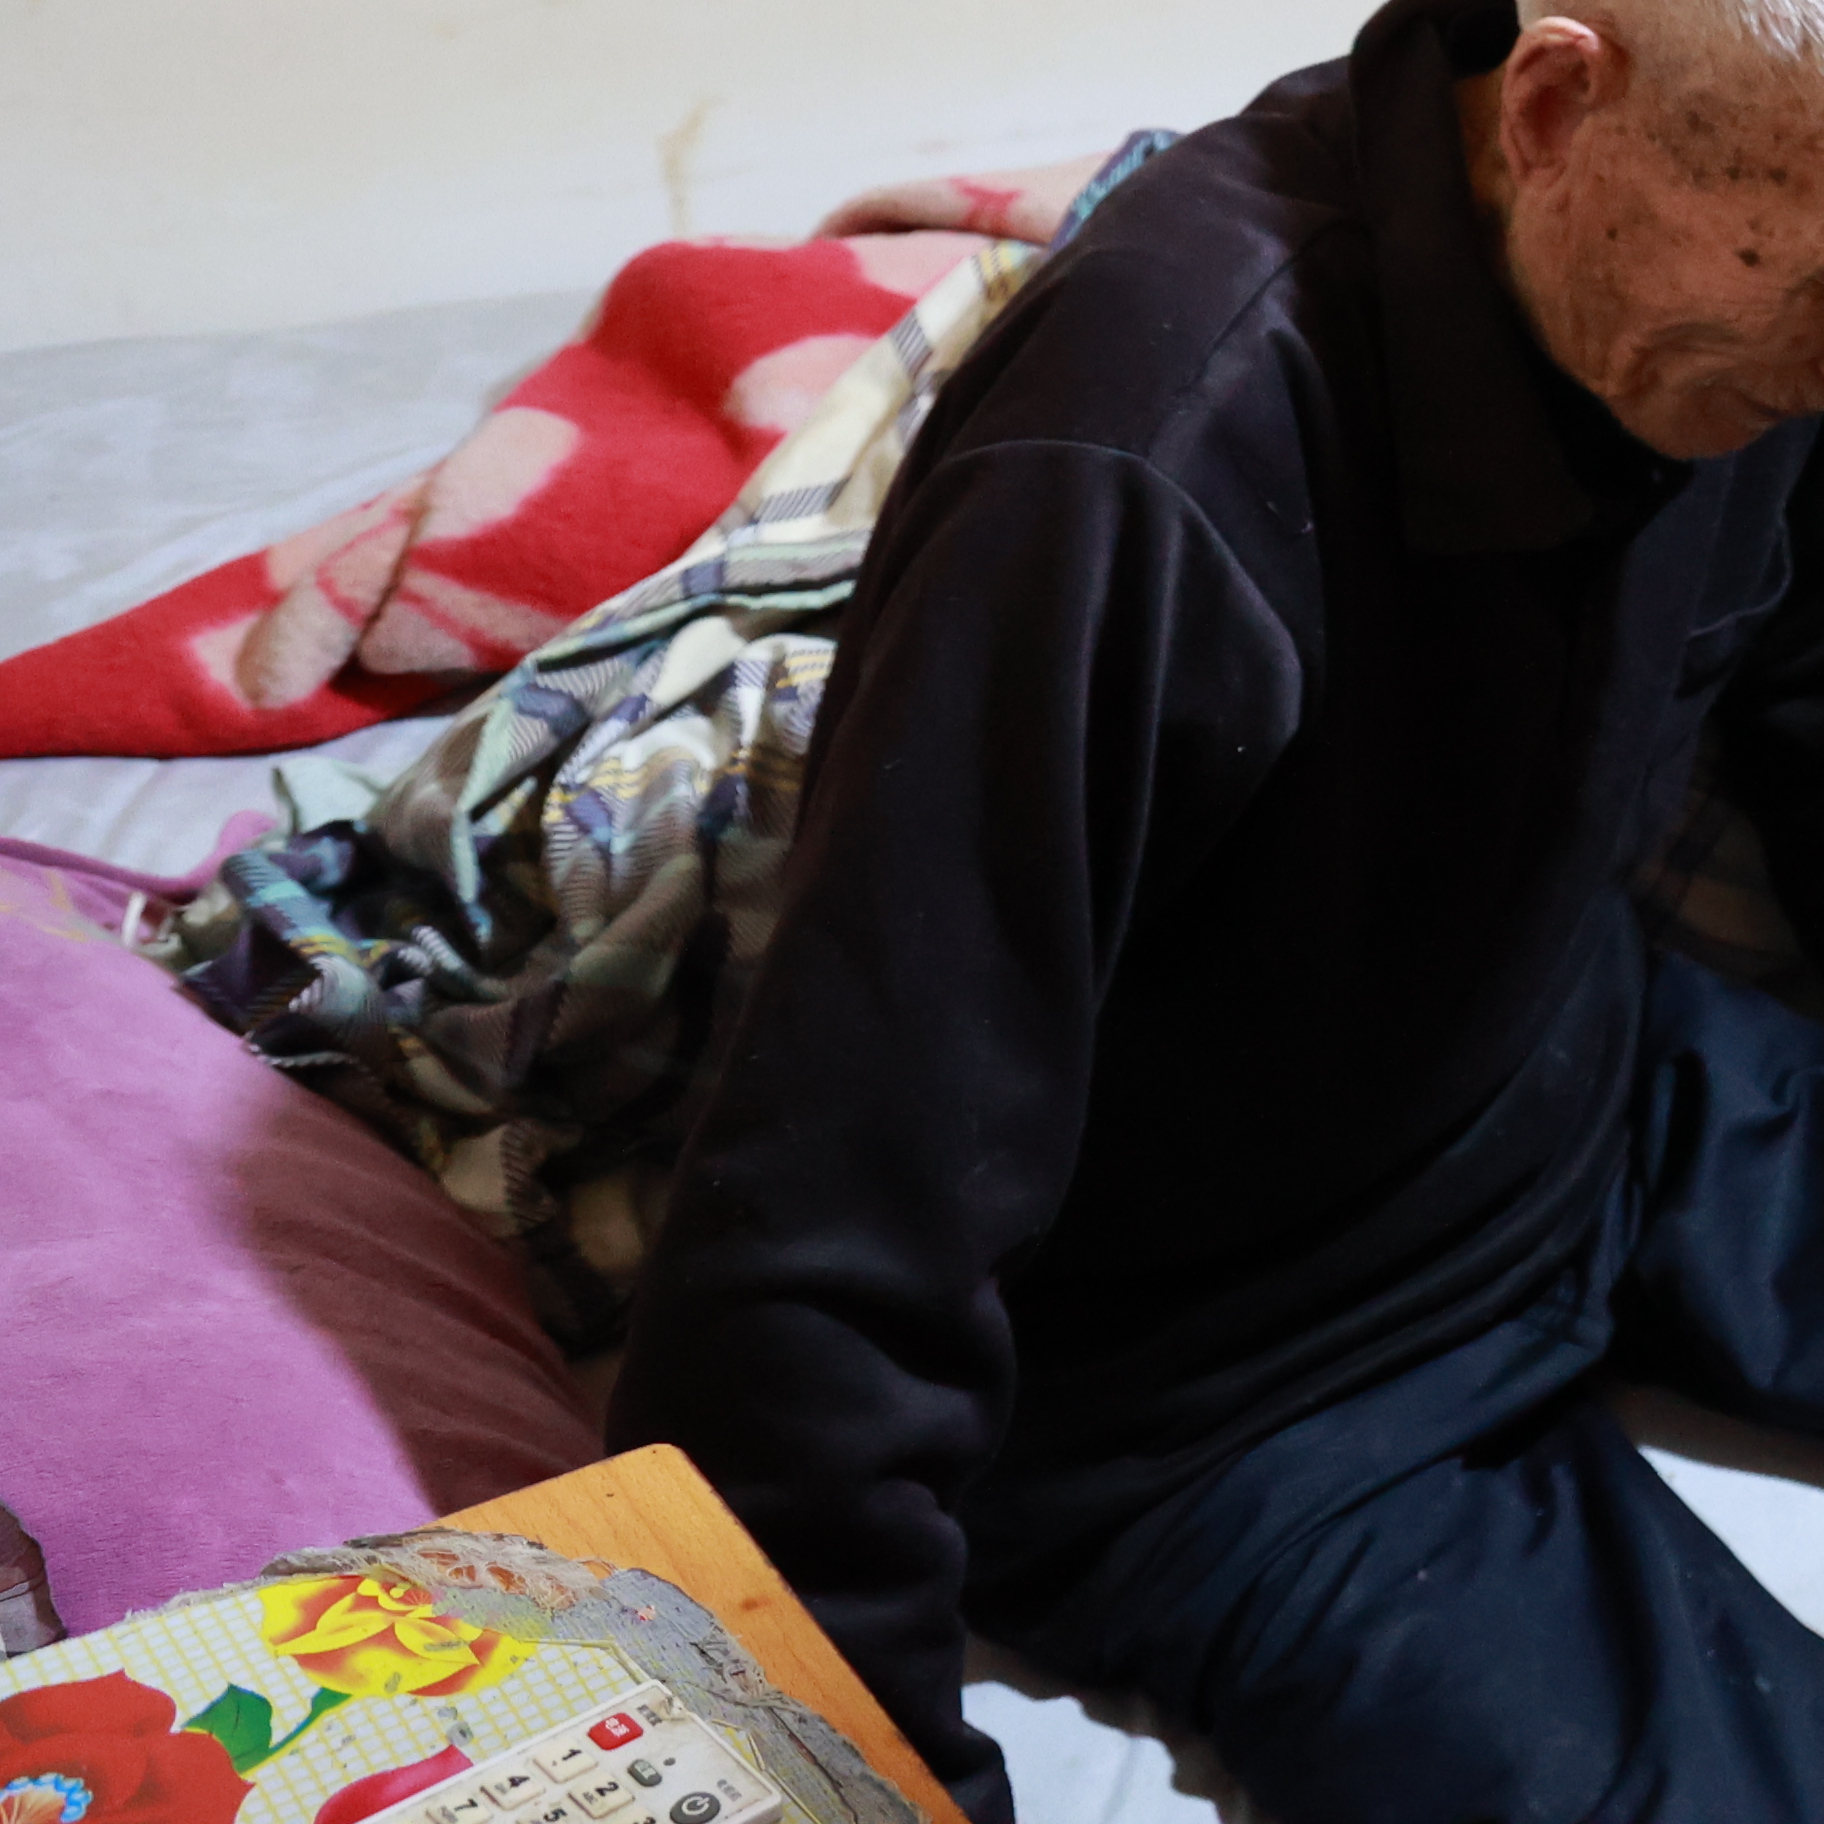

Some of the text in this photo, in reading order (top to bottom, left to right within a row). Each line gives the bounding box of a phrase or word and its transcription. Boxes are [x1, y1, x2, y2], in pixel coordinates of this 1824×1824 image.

[561, 1749, 582, 1761] 1
[508, 1776, 530, 1788] 4
[595, 1781, 620, 1797] 2
[454, 1798, 478, 1812] 7
[543, 1808, 568, 1823] 5
